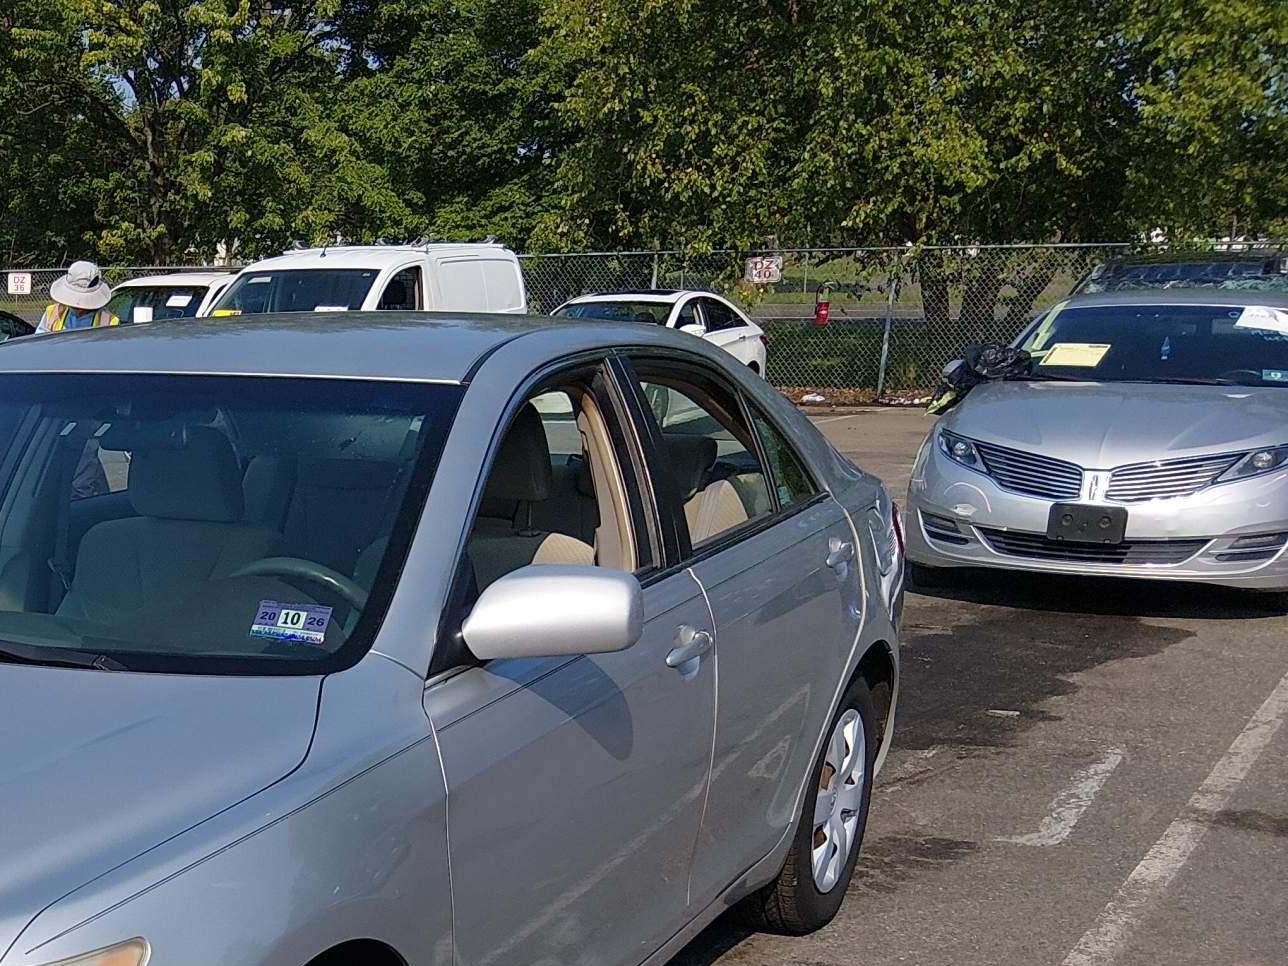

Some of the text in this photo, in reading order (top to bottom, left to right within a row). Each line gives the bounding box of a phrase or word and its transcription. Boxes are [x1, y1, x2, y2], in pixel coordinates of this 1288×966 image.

[754, 261, 773, 270] DZ
[755, 270, 771, 279] 40
[14, 276, 25, 284] DZ
[260, 611, 324, 626] 20 10 26
